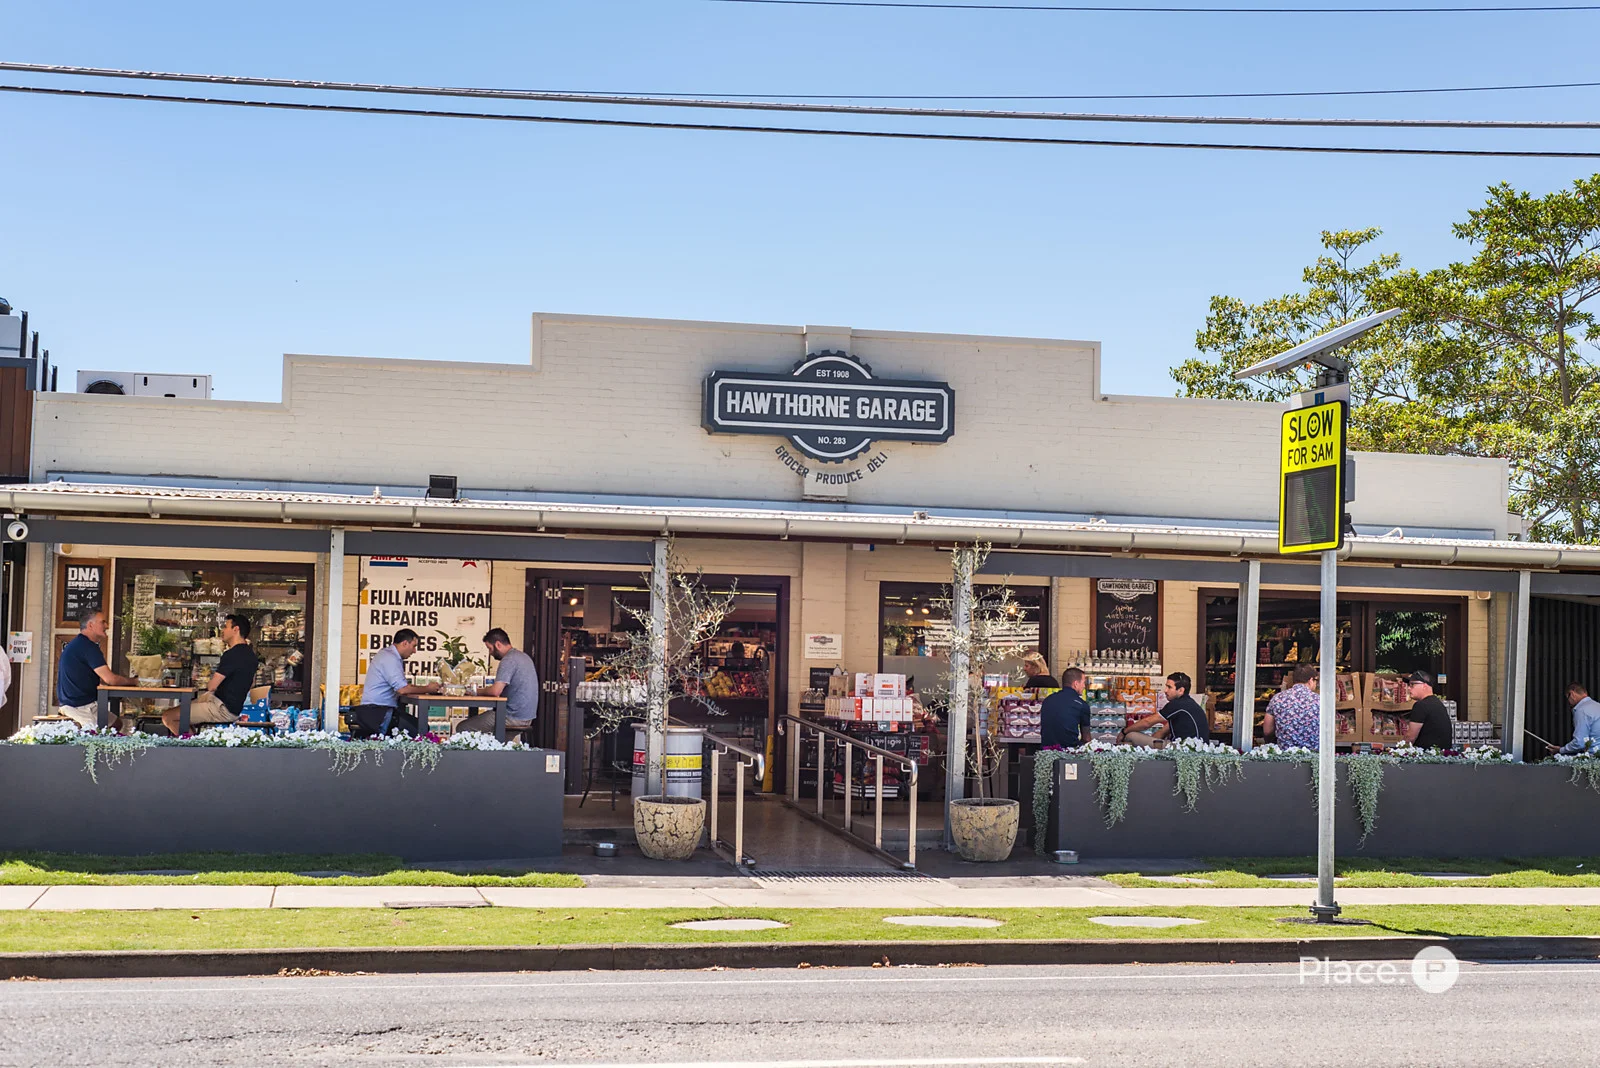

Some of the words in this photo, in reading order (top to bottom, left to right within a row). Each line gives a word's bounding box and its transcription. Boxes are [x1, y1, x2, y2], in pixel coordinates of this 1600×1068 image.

[816, 369, 831, 378] EST
[832, 370, 850, 379] 1908
[726, 390, 850, 419] HAWTHORNE
[856, 396, 937, 422] GARAGE
[1289, 409, 1334, 443] SLOW
[817, 436, 832, 444] NO.
[833, 437, 847, 445] 283
[1288, 446, 1307, 467] FOR
[1311, 441, 1334, 463] SAM
[775, 445, 809, 478] GROCER
[815, 469, 864, 485] PRODUCE
[866, 452, 888, 473] DELI
[68, 567, 100, 582] DNA
[67, 580, 98, 588] ESPRESSO
[370, 589, 402, 606] FULL
[405, 591, 490, 608] MECHANICAL
[370, 609, 438, 626] REPAIRS
[13, 646, 28, 654] ONLY
[370, 634, 437, 651] BRES
